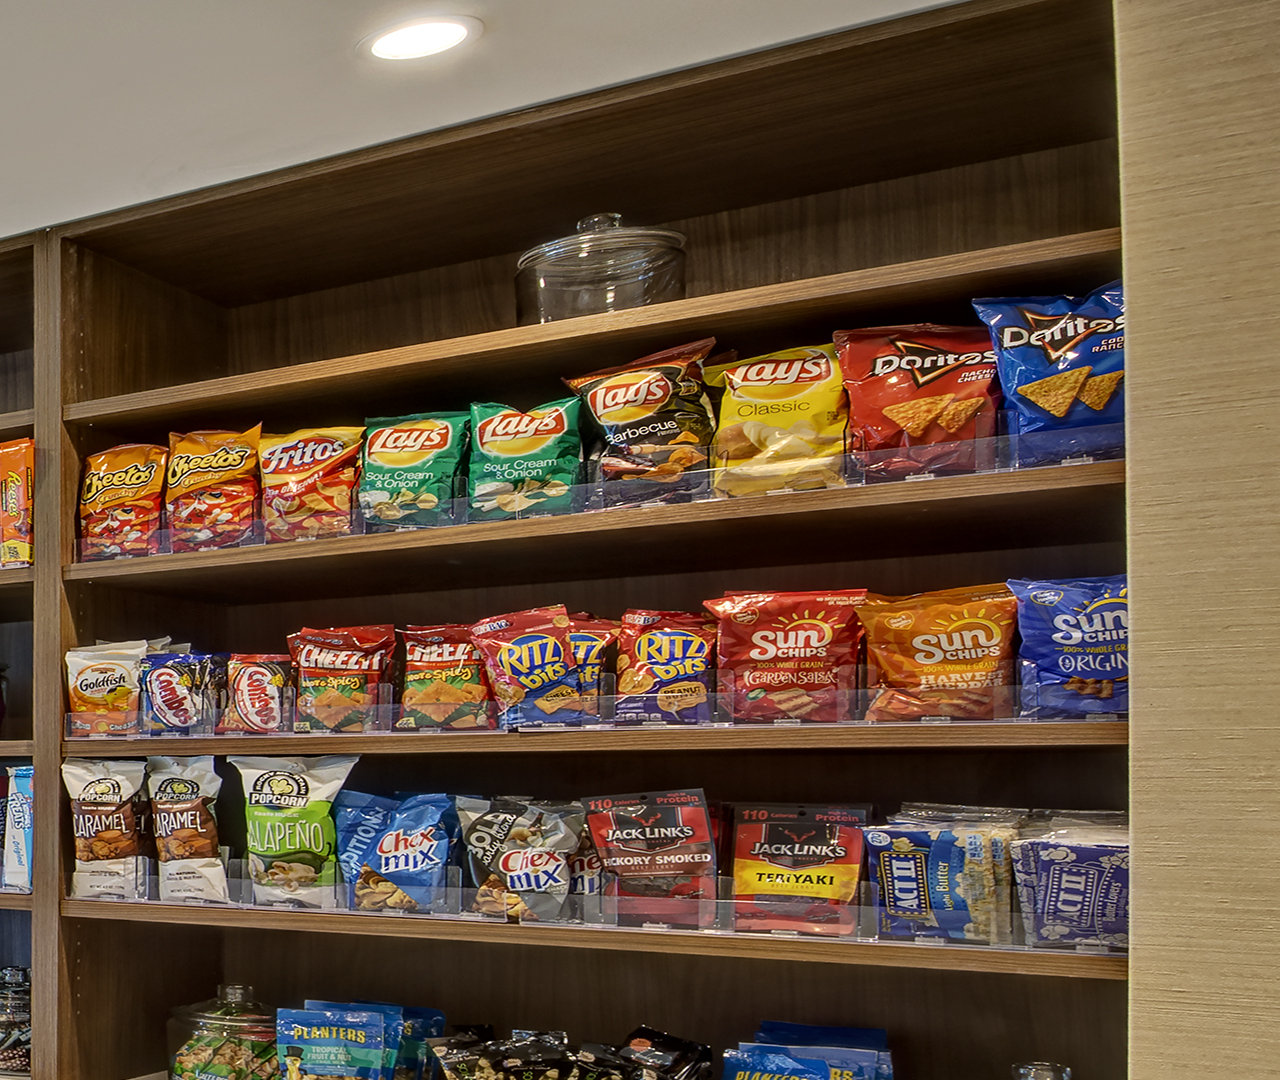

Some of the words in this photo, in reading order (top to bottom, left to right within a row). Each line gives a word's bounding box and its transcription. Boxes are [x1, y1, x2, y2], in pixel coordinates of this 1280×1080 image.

[1002, 314, 1125, 348] Doritos
[1092, 342, 1125, 353] RANC
[1101, 336, 1124, 346] COO
[874, 350, 998, 375] Doritos
[596, 378, 665, 417] Lay's
[737, 401, 811, 417] Classic
[482, 407, 562, 442] Lay's
[605, 420, 678, 445] Barbecue
[371, 427, 448, 452] Lay's
[262, 438, 344, 473] Fritos
[168, 448, 248, 487] Cheetos
[483, 462, 511, 473] Sour
[512, 458, 557, 470] Cream
[495, 471, 503, 480] &
[504, 467, 542, 479] Onion
[83, 464, 155, 502] Cheetos
[365, 471, 392, 482] Sour
[394, 470, 433, 481] Cream
[375, 479, 383, 488] &
[384, 478, 419, 488] Onion
[1083, 630, 1127, 643] CHIP
[499, 638, 559, 675] RITZ
[639, 634, 700, 665] RITZ
[775, 648, 827, 659] CHIPS
[945, 646, 1001, 660] CHIPS
[656, 657, 707, 680] bits
[1058, 654, 1128, 672] ORIGIN
[79, 673, 127, 693] Goldfish
[518, 663, 569, 690] bits
[920, 670, 1004, 685] HARVEST
[80, 793, 121, 803] POPCORN
[156, 792, 199, 802] POPCORN
[251, 793, 307, 807] POPCORN
[588, 799, 612, 810] 110
[742, 810, 769, 821] 110
[248, 820, 324, 852] ALAPEÑO
[378, 827, 435, 855] Chex
[606, 828, 645, 841] JACK
[646, 826, 694, 839] LINK'S
[750, 842, 793, 856] JACK
[794, 843, 847, 858] LINK'S
[501, 850, 562, 873] Chex
[655, 853, 712, 864] SMOKED
[756, 872, 835, 886] TERIYAKI
[294, 1026, 366, 1044] PLANTERS
